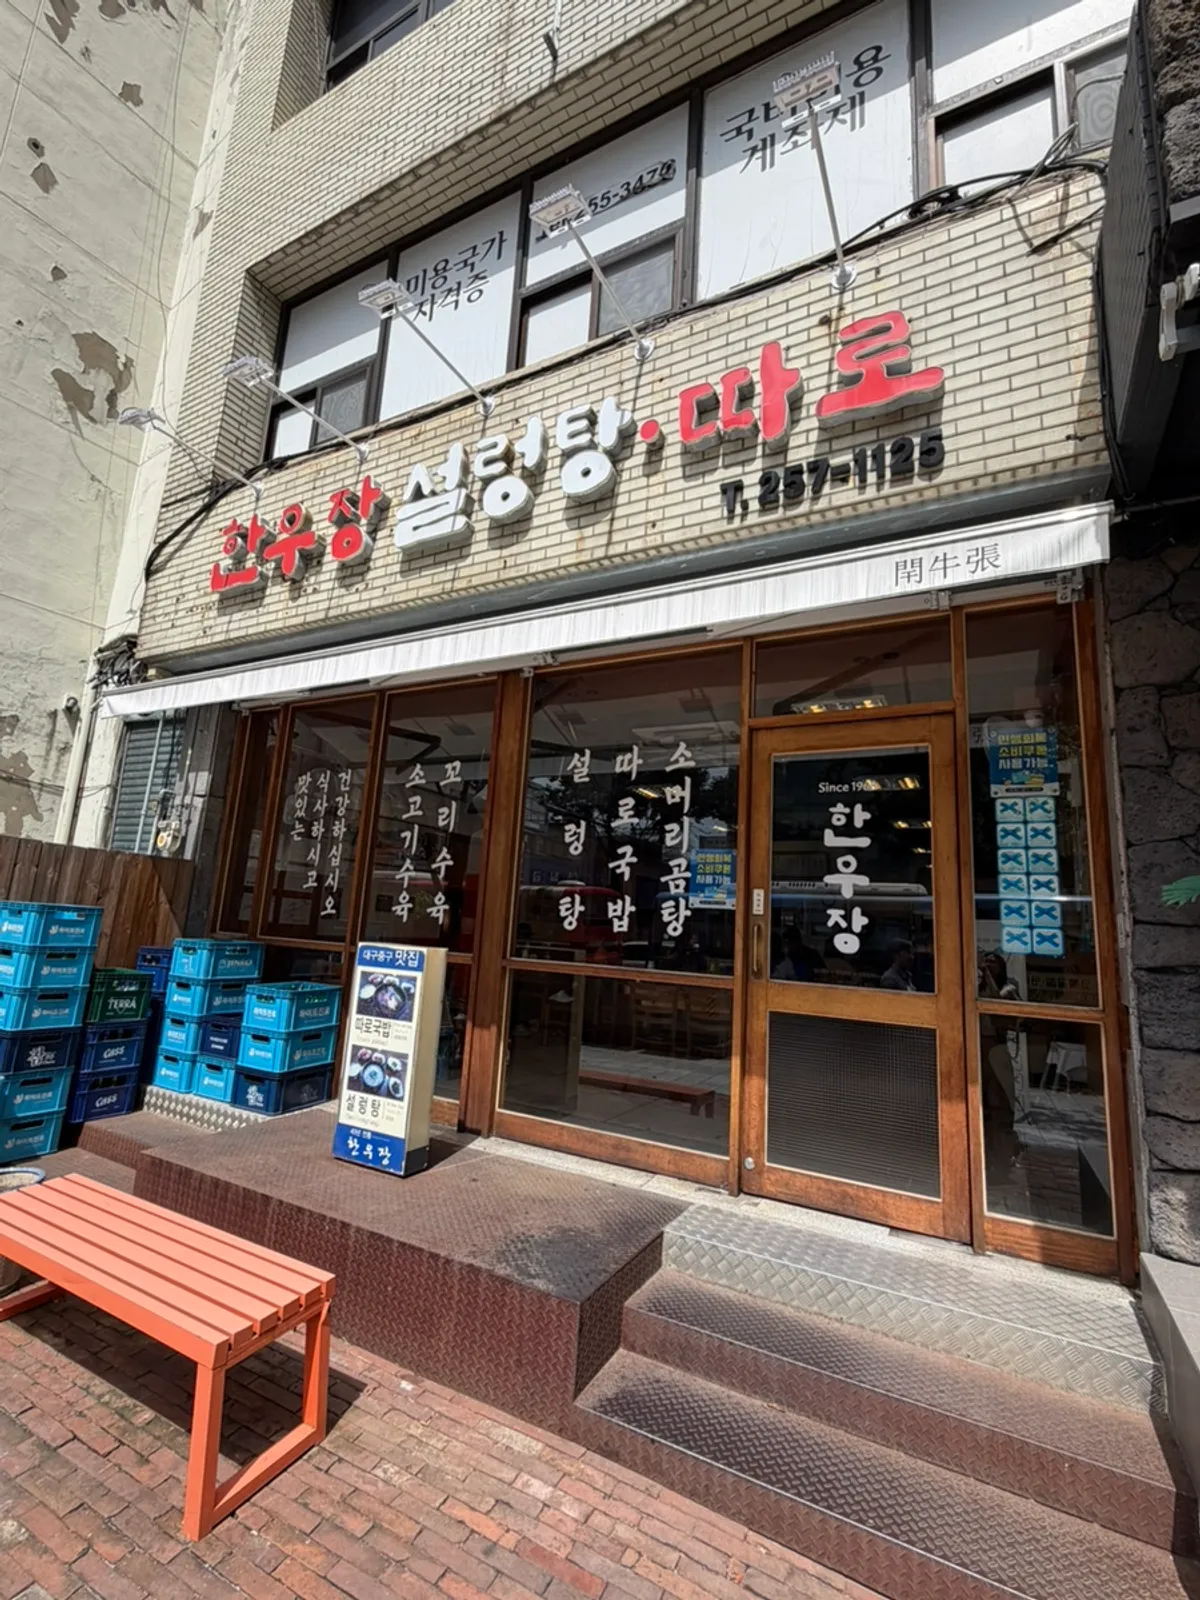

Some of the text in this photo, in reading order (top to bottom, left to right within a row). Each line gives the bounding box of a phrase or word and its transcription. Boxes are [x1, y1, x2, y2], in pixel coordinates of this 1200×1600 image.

[405, 230, 508, 297] 미용국가
[411, 269, 490, 323] 자격증
[210, 474, 388, 593] 한우장
[290, 771, 313, 841] 맛있는
[302, 769, 331, 889] 식사하시고
[818, 781, 850, 794] Since
[320, 768, 352, 916] 건강하십시오
[391, 762, 427, 923] 소고기수육
[426, 759, 462, 925] 꼬리수육
[557, 748, 592, 931] 설렁탕
[606, 744, 644, 933] 따로국밥
[659, 741, 697, 937] 소머리곰탕
[823, 801, 873, 956] 한우장
[108, 996, 138, 1010] TERRA
[362, 948, 419, 968] 대구중구 맛집
[103, 1045, 126, 1059] Cass
[95, 1093, 118, 1108] Cass
[346, 1135, 392, 1166] 한우장
